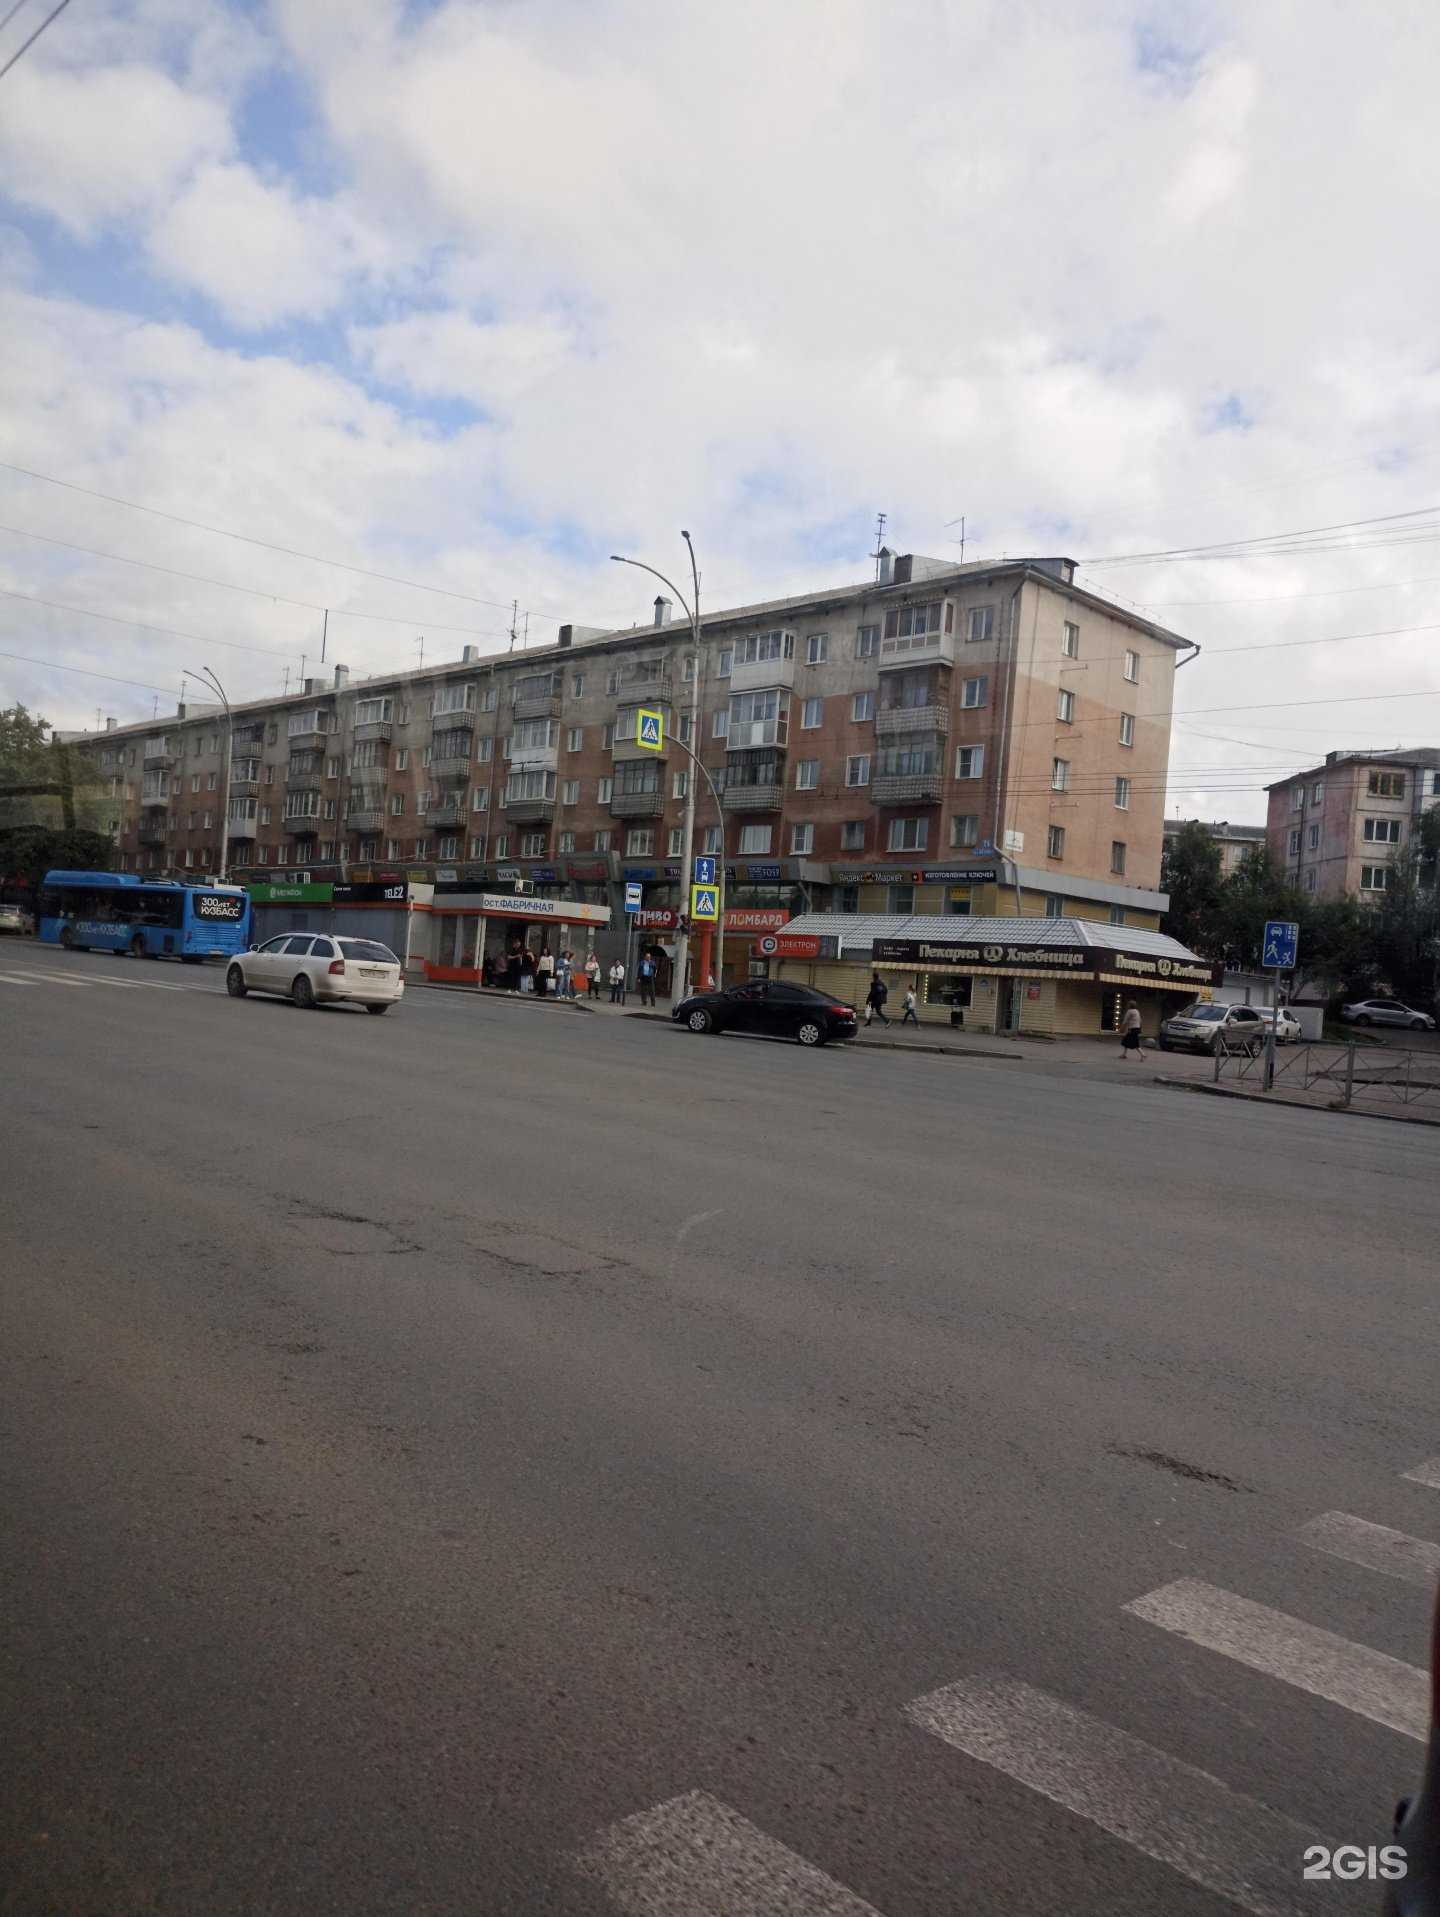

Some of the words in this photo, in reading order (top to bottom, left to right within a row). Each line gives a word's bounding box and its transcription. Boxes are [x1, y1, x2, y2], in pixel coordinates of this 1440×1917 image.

[384, 886, 404, 899] TELE2
[200, 906, 240, 917] КУЗБАСС
[729, 913, 783, 926] ЛОМБАРД
[919, 944, 980, 963] Пекарня
[1006, 948, 1084, 967] Хлебница
